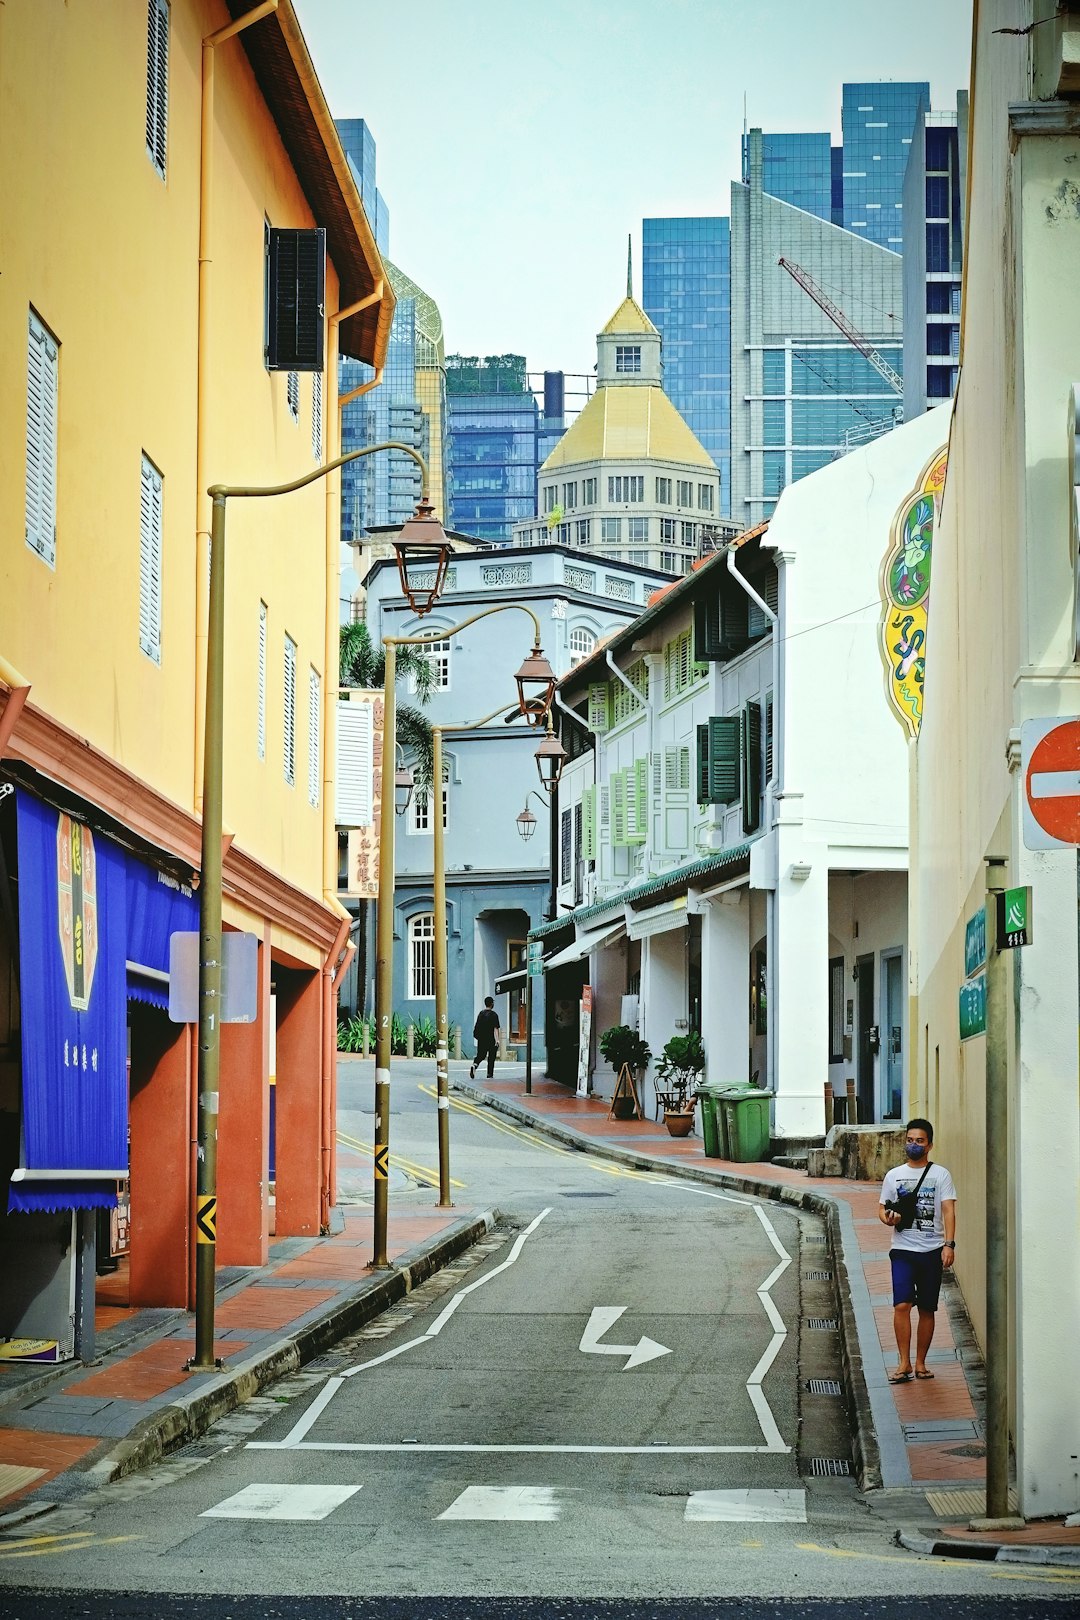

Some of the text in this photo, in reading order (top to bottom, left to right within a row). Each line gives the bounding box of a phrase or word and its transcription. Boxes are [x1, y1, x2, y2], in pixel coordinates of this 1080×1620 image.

[208, 1013, 215, 1030] 1
[382, 1015, 388, 1028] 2
[441, 1014, 446, 1024] 3
